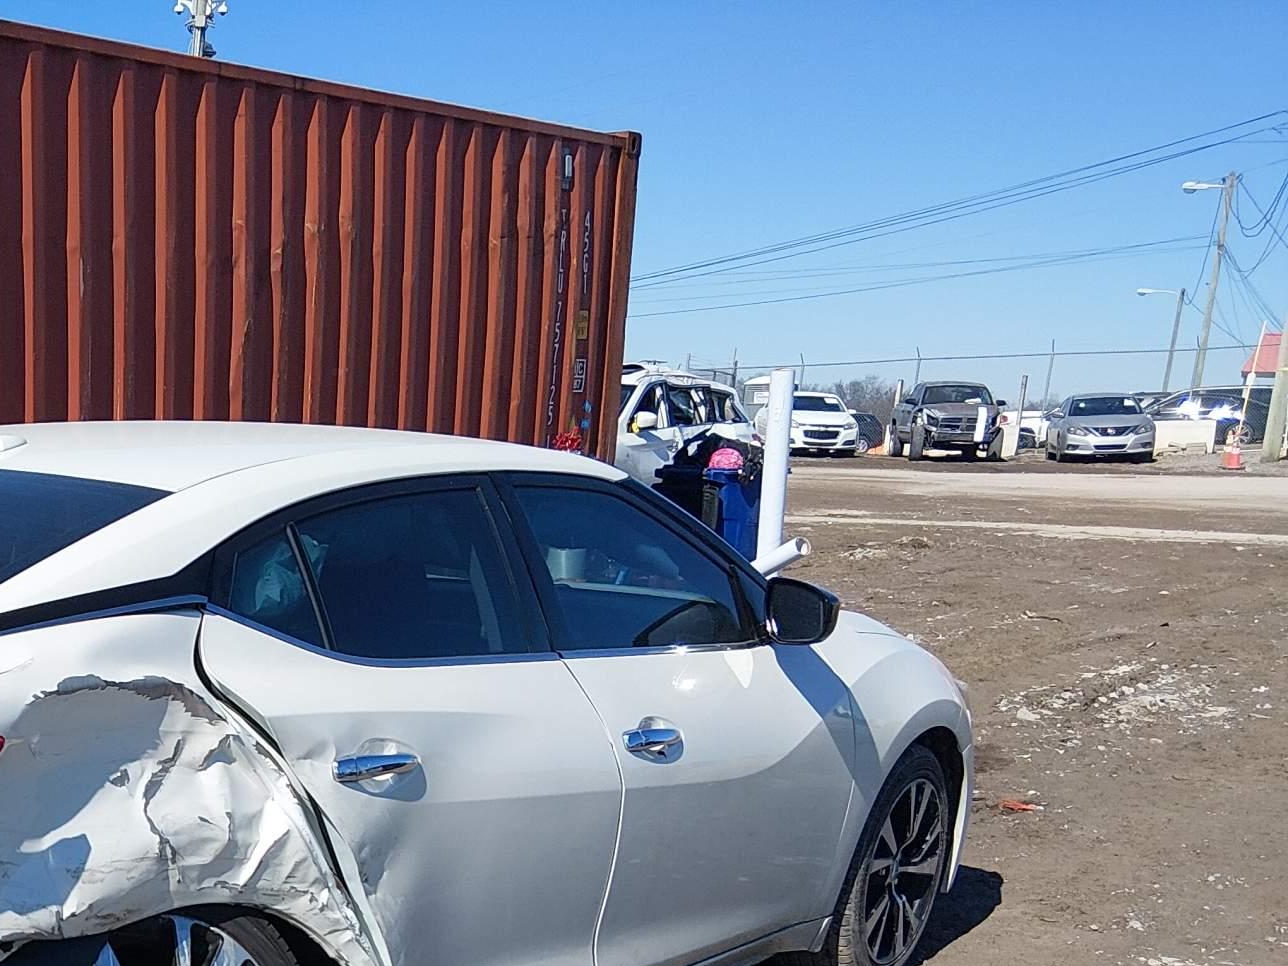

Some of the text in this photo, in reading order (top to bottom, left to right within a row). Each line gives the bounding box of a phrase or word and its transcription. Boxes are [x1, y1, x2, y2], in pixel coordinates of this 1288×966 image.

[558, 208, 567, 294] TRLU
[583, 210, 591, 294] 45G1
[547, 301, 562, 426] 757125
